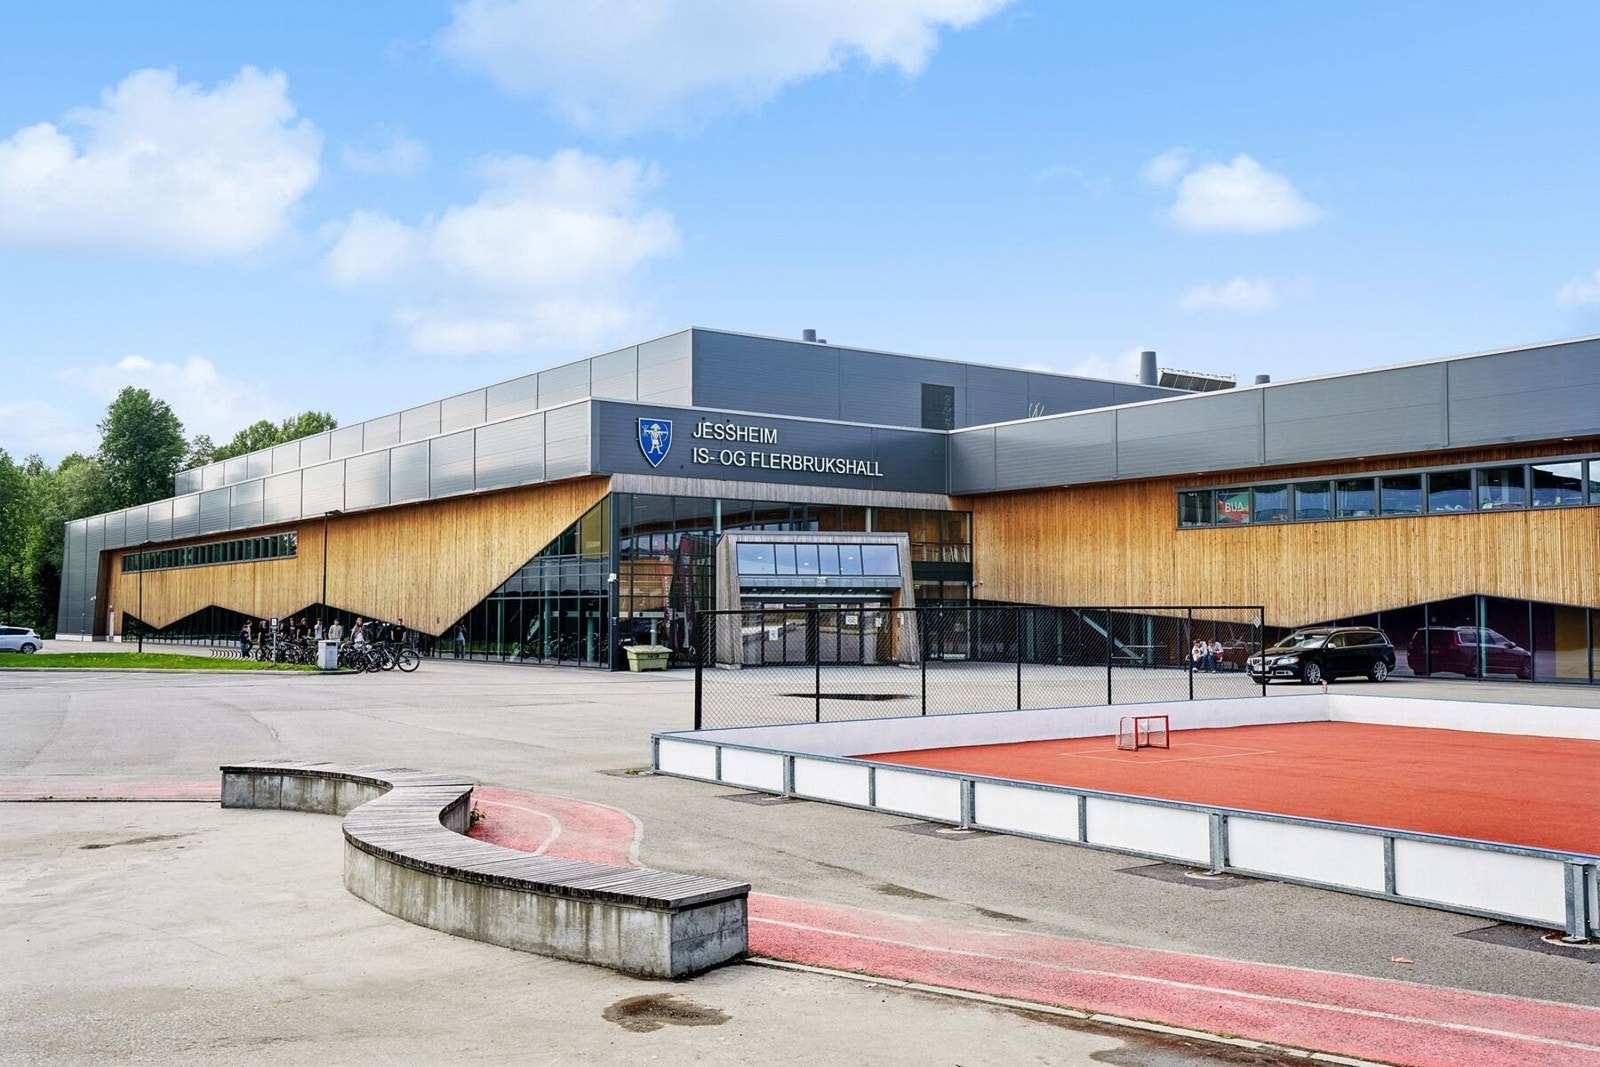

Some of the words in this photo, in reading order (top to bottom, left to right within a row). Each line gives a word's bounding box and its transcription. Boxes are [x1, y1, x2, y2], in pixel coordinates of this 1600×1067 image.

[693, 422, 777, 444] JESSHEIM
[693, 447, 715, 464] IS-
[720, 449, 746, 466] OG
[751, 451, 883, 477] FLERBRUKSHALL
